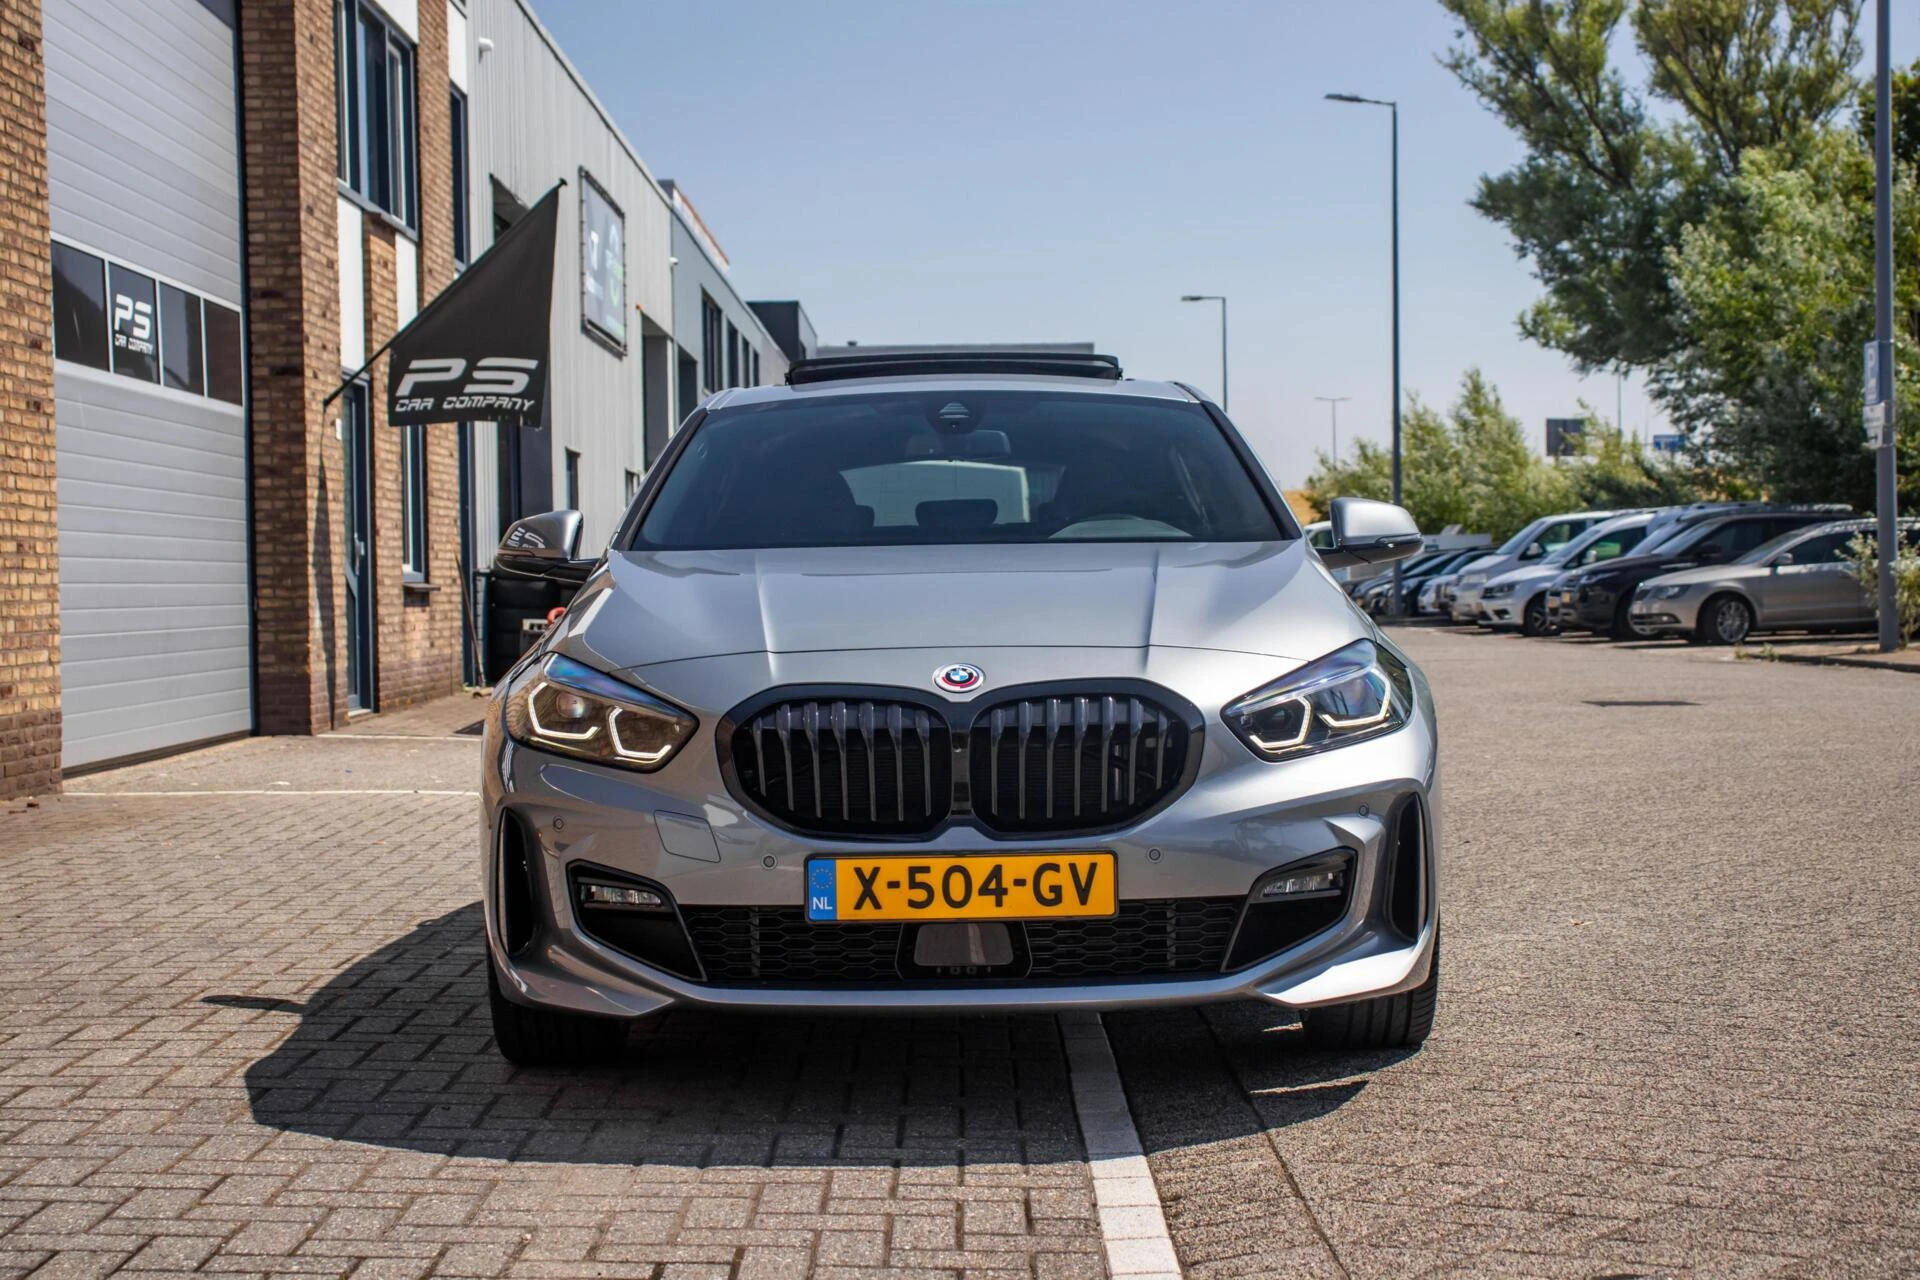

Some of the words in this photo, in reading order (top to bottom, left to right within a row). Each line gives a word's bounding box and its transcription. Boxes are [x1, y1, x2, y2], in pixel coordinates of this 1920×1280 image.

[114, 293, 152, 340] PS
[395, 357, 539, 397] PS
[395, 398, 435, 412] CAR
[442, 396, 535, 412] COMPANY
[812, 896, 833, 911] NL
[853, 861, 1098, 911] X-504-GV
